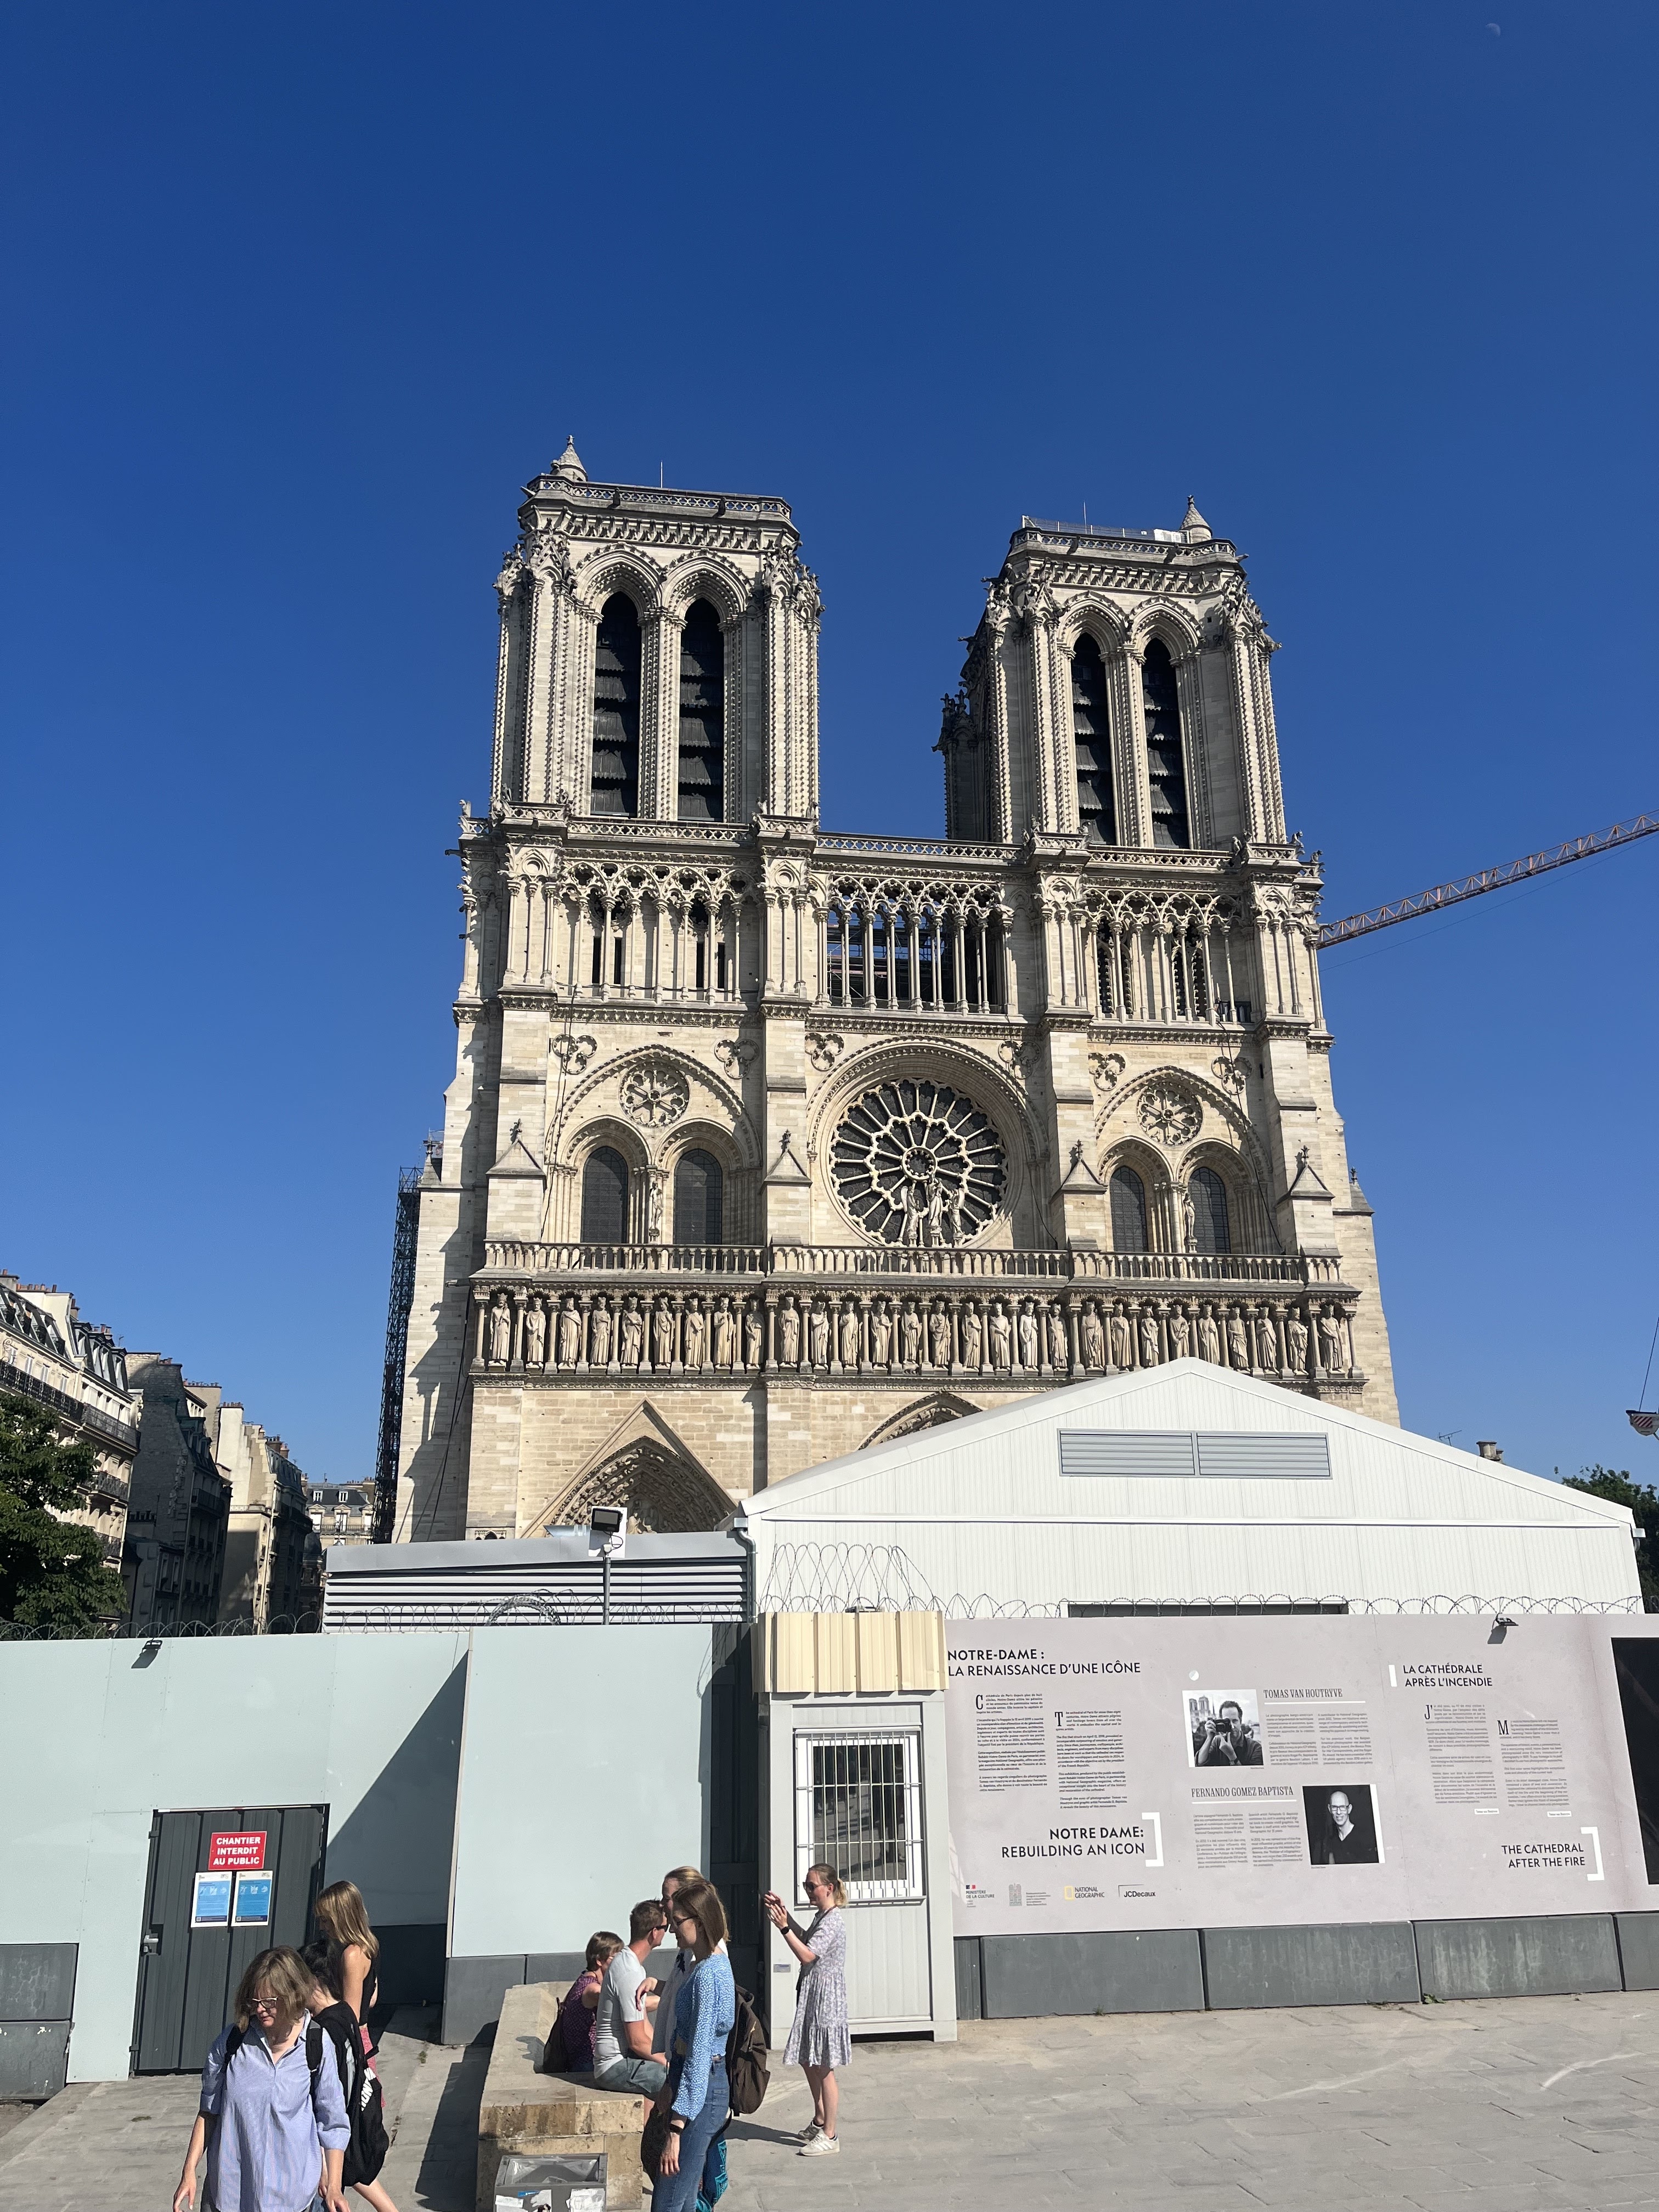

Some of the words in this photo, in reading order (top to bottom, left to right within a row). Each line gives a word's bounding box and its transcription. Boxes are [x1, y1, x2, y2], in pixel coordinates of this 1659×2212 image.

[947, 1649, 1037, 1661] NOTRE-DAME
[948, 1666, 964, 1677] LA
[968, 1664, 1056, 1676] RENAISSANCE
[1059, 1663, 1098, 1674] D'UNE
[1102, 1660, 1141, 1673] ICÔNE
[1403, 1665, 1416, 1674] LA
[1418, 1662, 1483, 1674] CATHÉDRALE
[1405, 1675, 1436, 1687] APRÈS
[1438, 1677, 1493, 1686] L'INCENDIE
[1263, 1689, 1289, 1698] TOMAS
[1290, 1689, 1304, 1697] VAN
[1305, 1689, 1343, 1697] HOUTRYVE
[1192, 1787, 1230, 1797] FERNANDO
[1232, 1787, 1257, 1797] GOMEZ
[1257, 1786, 1293, 1796] BAPTISTA
[1049, 1827, 1096, 1840] NOTRE
[1100, 1826, 1144, 1838] DAME:
[216, 1837, 261, 1845] CHANTIER
[217, 1847, 258, 1855] INTERDIT
[1002, 1844, 1082, 1858] REBUILDING
[1087, 1843, 1107, 1855] AN
[1111, 1843, 1144, 1855] ICON
[1501, 1844, 1522, 1854] THE
[1524, 1843, 1584, 1854] CATHEDRAL
[228, 1857, 260, 1865] PUBLIC
[1508, 1858, 1541, 1868] AFTER
[1542, 1857, 1562, 1867] THE
[1565, 1857, 1585, 1866] FIRE
